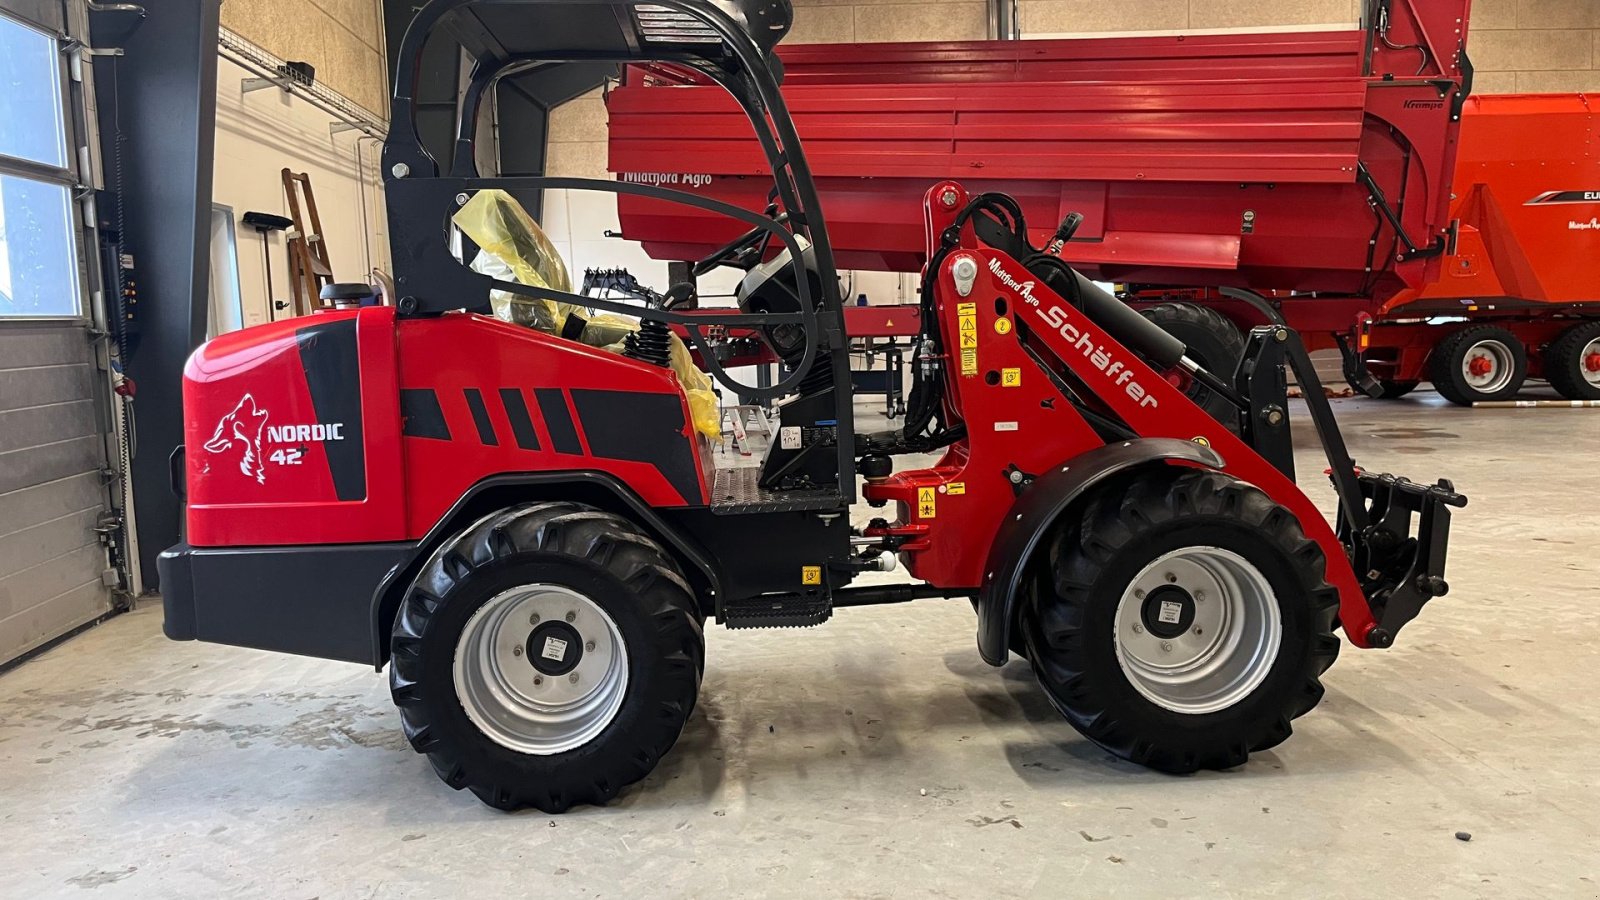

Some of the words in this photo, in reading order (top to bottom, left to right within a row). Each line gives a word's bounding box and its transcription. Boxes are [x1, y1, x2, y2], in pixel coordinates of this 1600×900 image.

[681, 173, 712, 188] Agro
[988, 257, 1022, 292] Midtfjord
[1019, 282, 1040, 307] Agro
[1036, 305, 1158, 409] Schäffer
[267, 423, 344, 443] NORDIC
